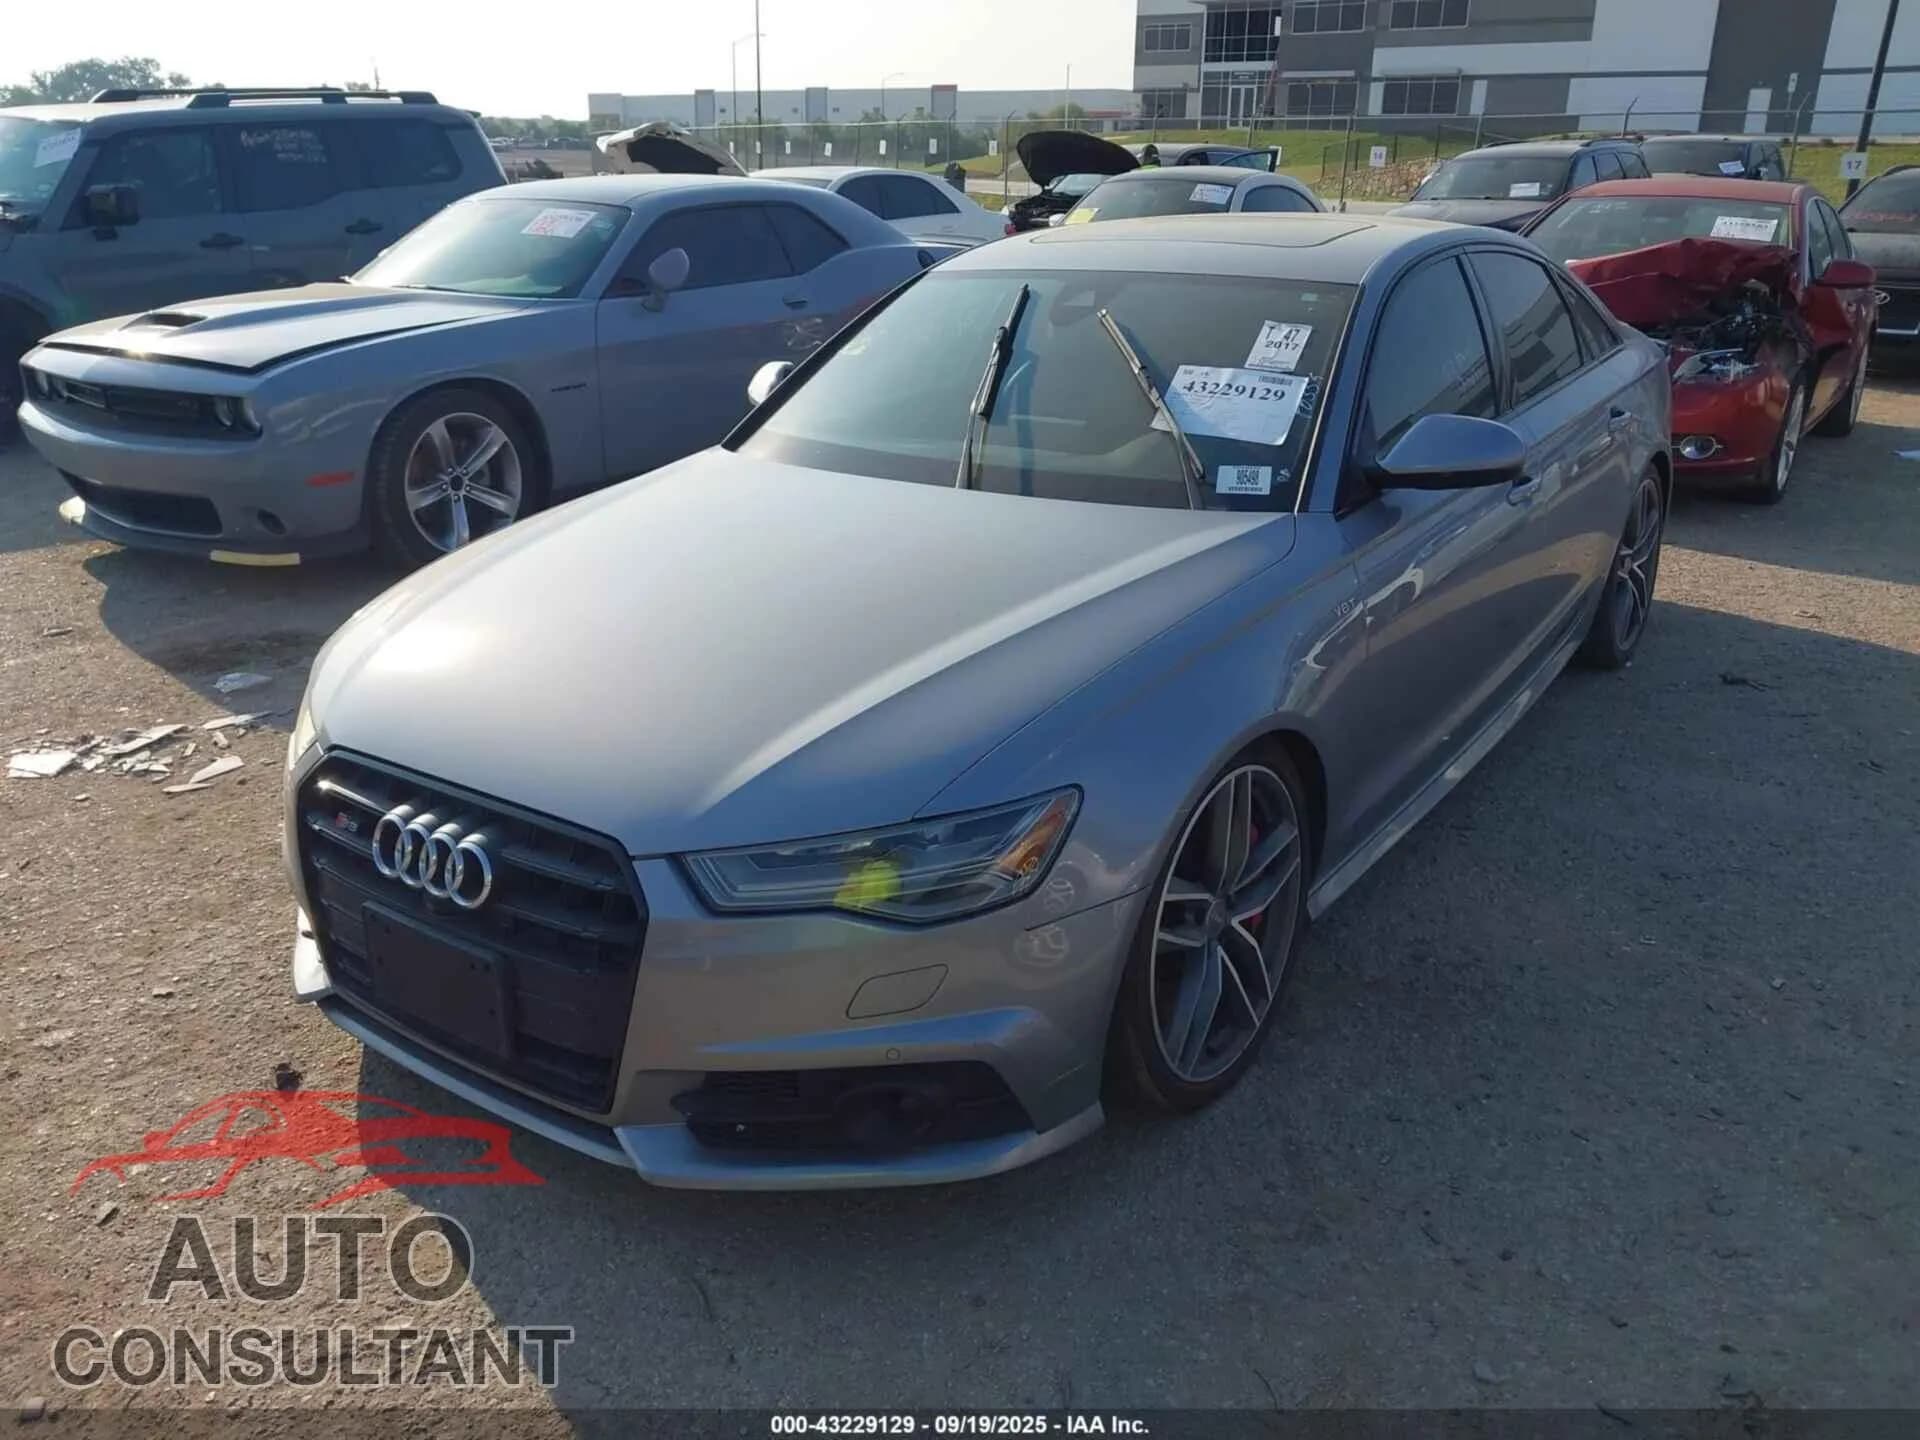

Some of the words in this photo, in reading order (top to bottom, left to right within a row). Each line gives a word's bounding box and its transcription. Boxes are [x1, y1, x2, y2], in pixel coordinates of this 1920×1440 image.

[1847, 160, 1862, 169] 17
[1265, 340, 1301, 350] 2017
[1183, 380, 1286, 401] 43229129
